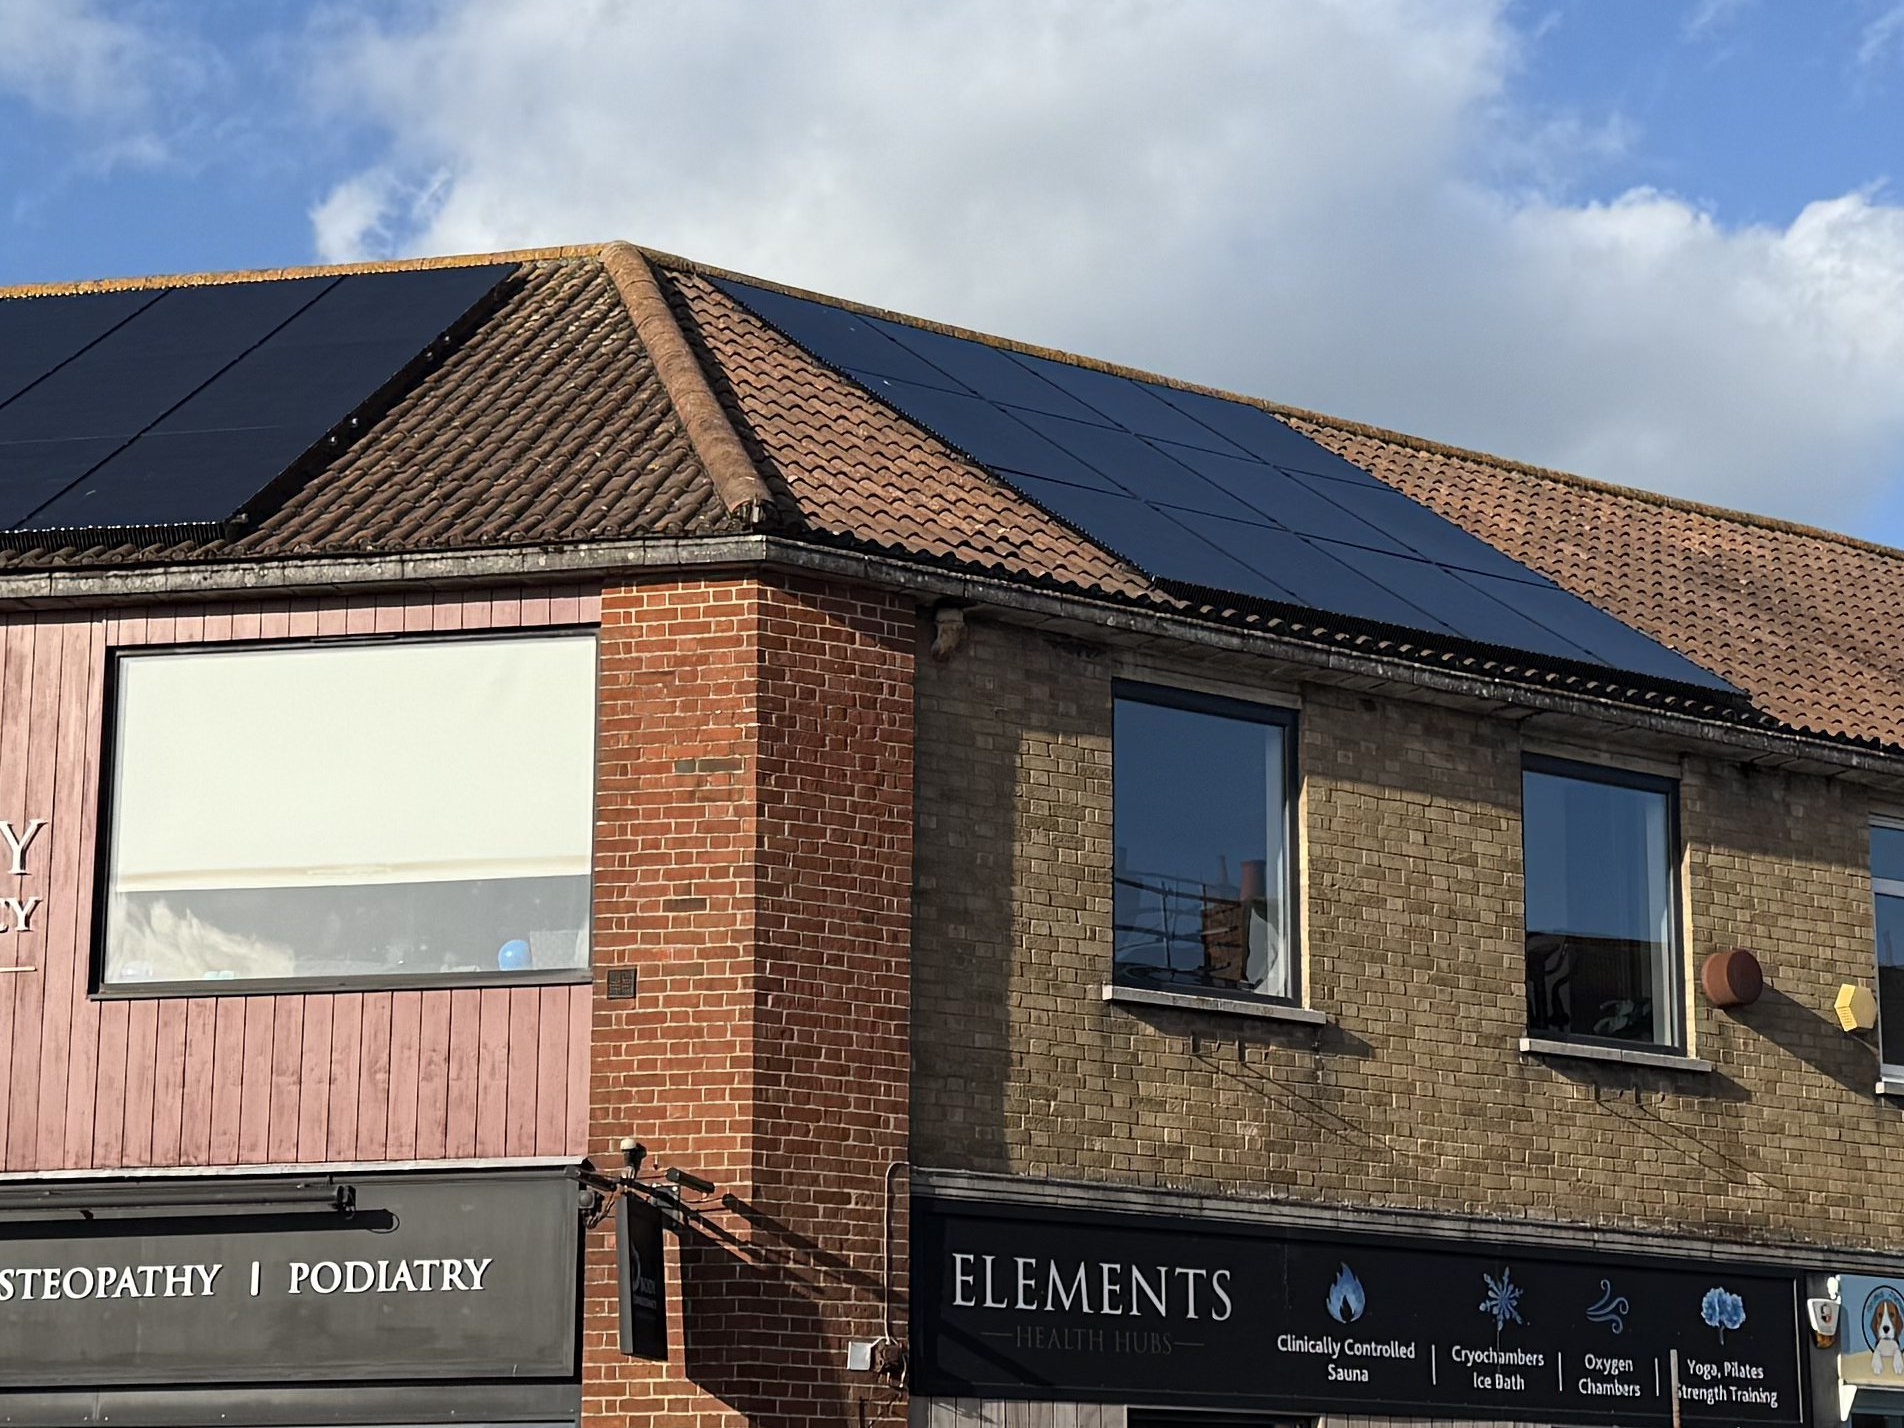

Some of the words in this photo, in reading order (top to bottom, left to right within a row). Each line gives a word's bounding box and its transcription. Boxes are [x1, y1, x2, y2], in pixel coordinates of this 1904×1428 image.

[288, 1258, 493, 1295] PODIATRY
[951, 1252, 1233, 1322] ELEMENTS
[1016, 1326, 1103, 1352] HEALTH
[1115, 1330, 1173, 1356] HUBS
[1277, 1335, 1341, 1358] Clinically
[1344, 1339, 1416, 1359] Controlled
[1451, 1345, 1545, 1367] Cryochambers
[1584, 1353, 1633, 1376] Oxygen
[1327, 1363, 1369, 1383] Sauna
[1687, 1359, 1721, 1380] Yoga,
[1724, 1361, 1764, 1379] Pilates
[1473, 1372, 1492, 1389] Ice
[1495, 1373, 1525, 1391] Bath
[1578, 1378, 1641, 1397] Chambers
[1731, 1386, 1778, 1409] Training
